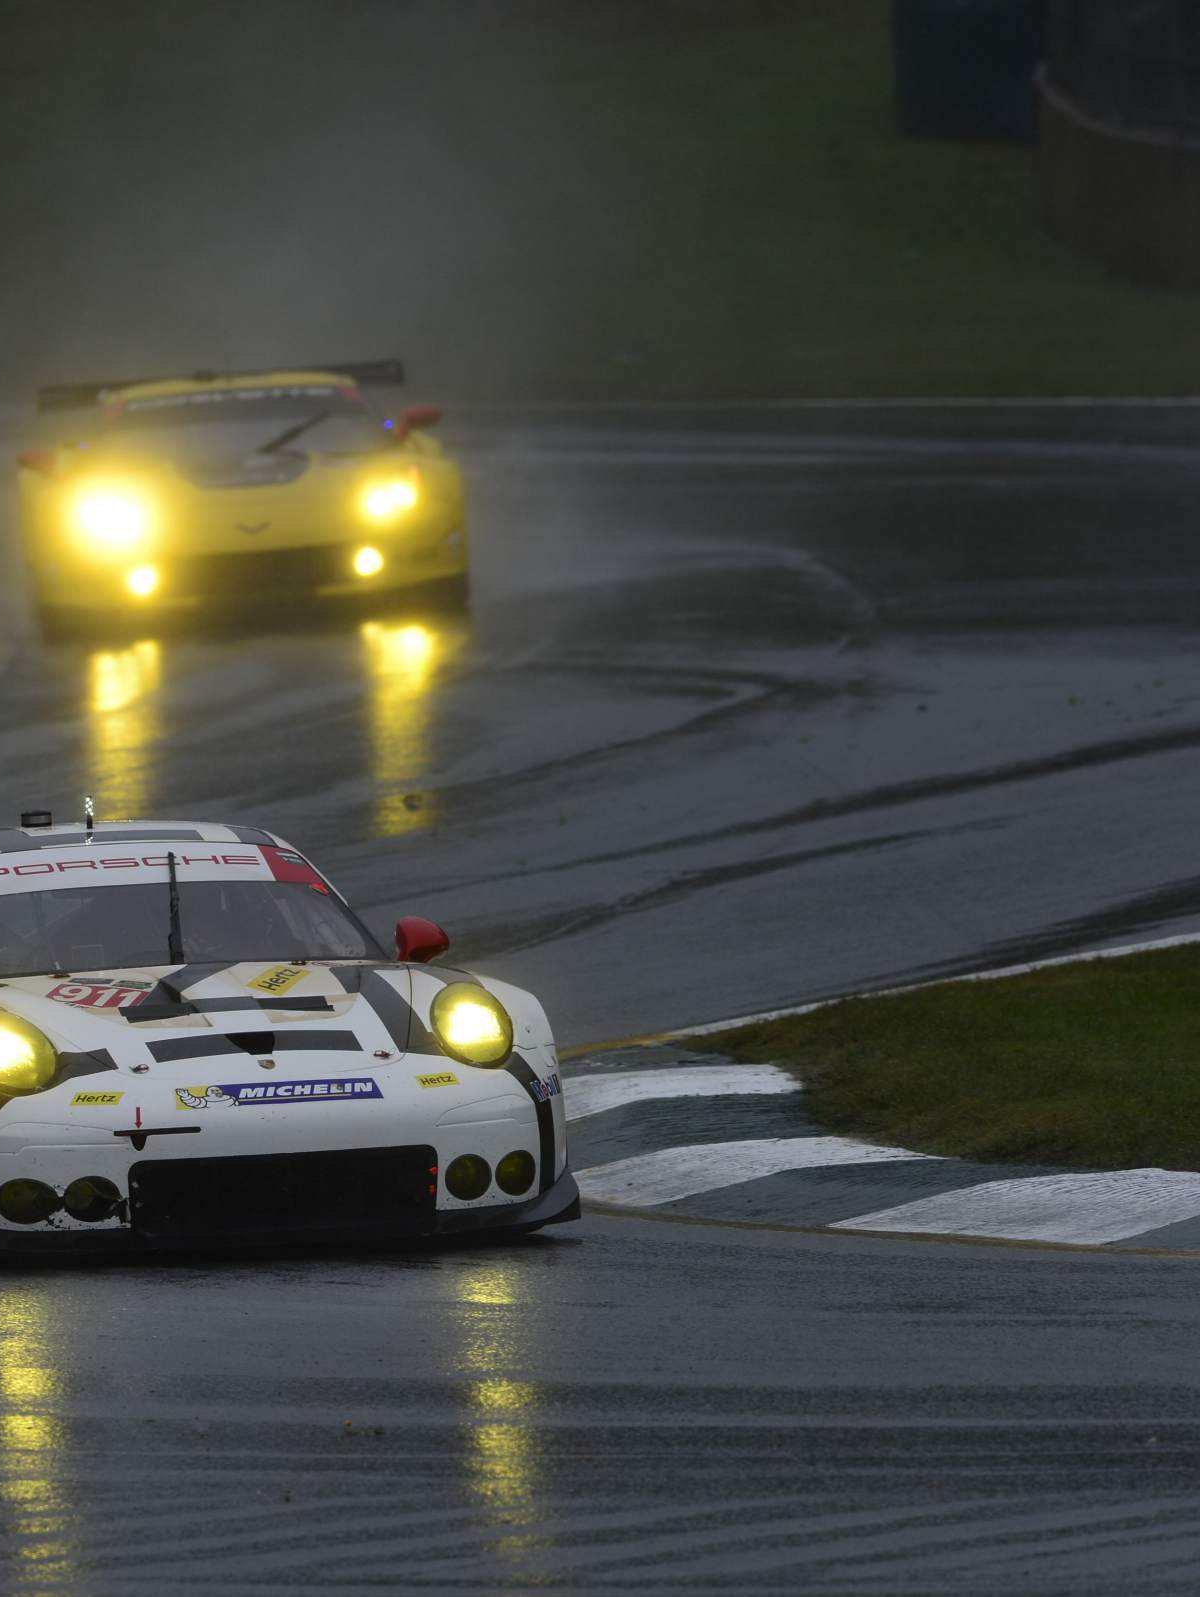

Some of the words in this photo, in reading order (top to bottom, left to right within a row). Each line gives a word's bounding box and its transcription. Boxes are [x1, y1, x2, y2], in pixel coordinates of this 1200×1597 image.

[257, 967, 300, 992] Hertz
[52, 984, 137, 1008] 911
[420, 1074, 454, 1087] Hertz
[75, 1092, 116, 1105] Hertz
[238, 1081, 373, 1099] MICHELIN
